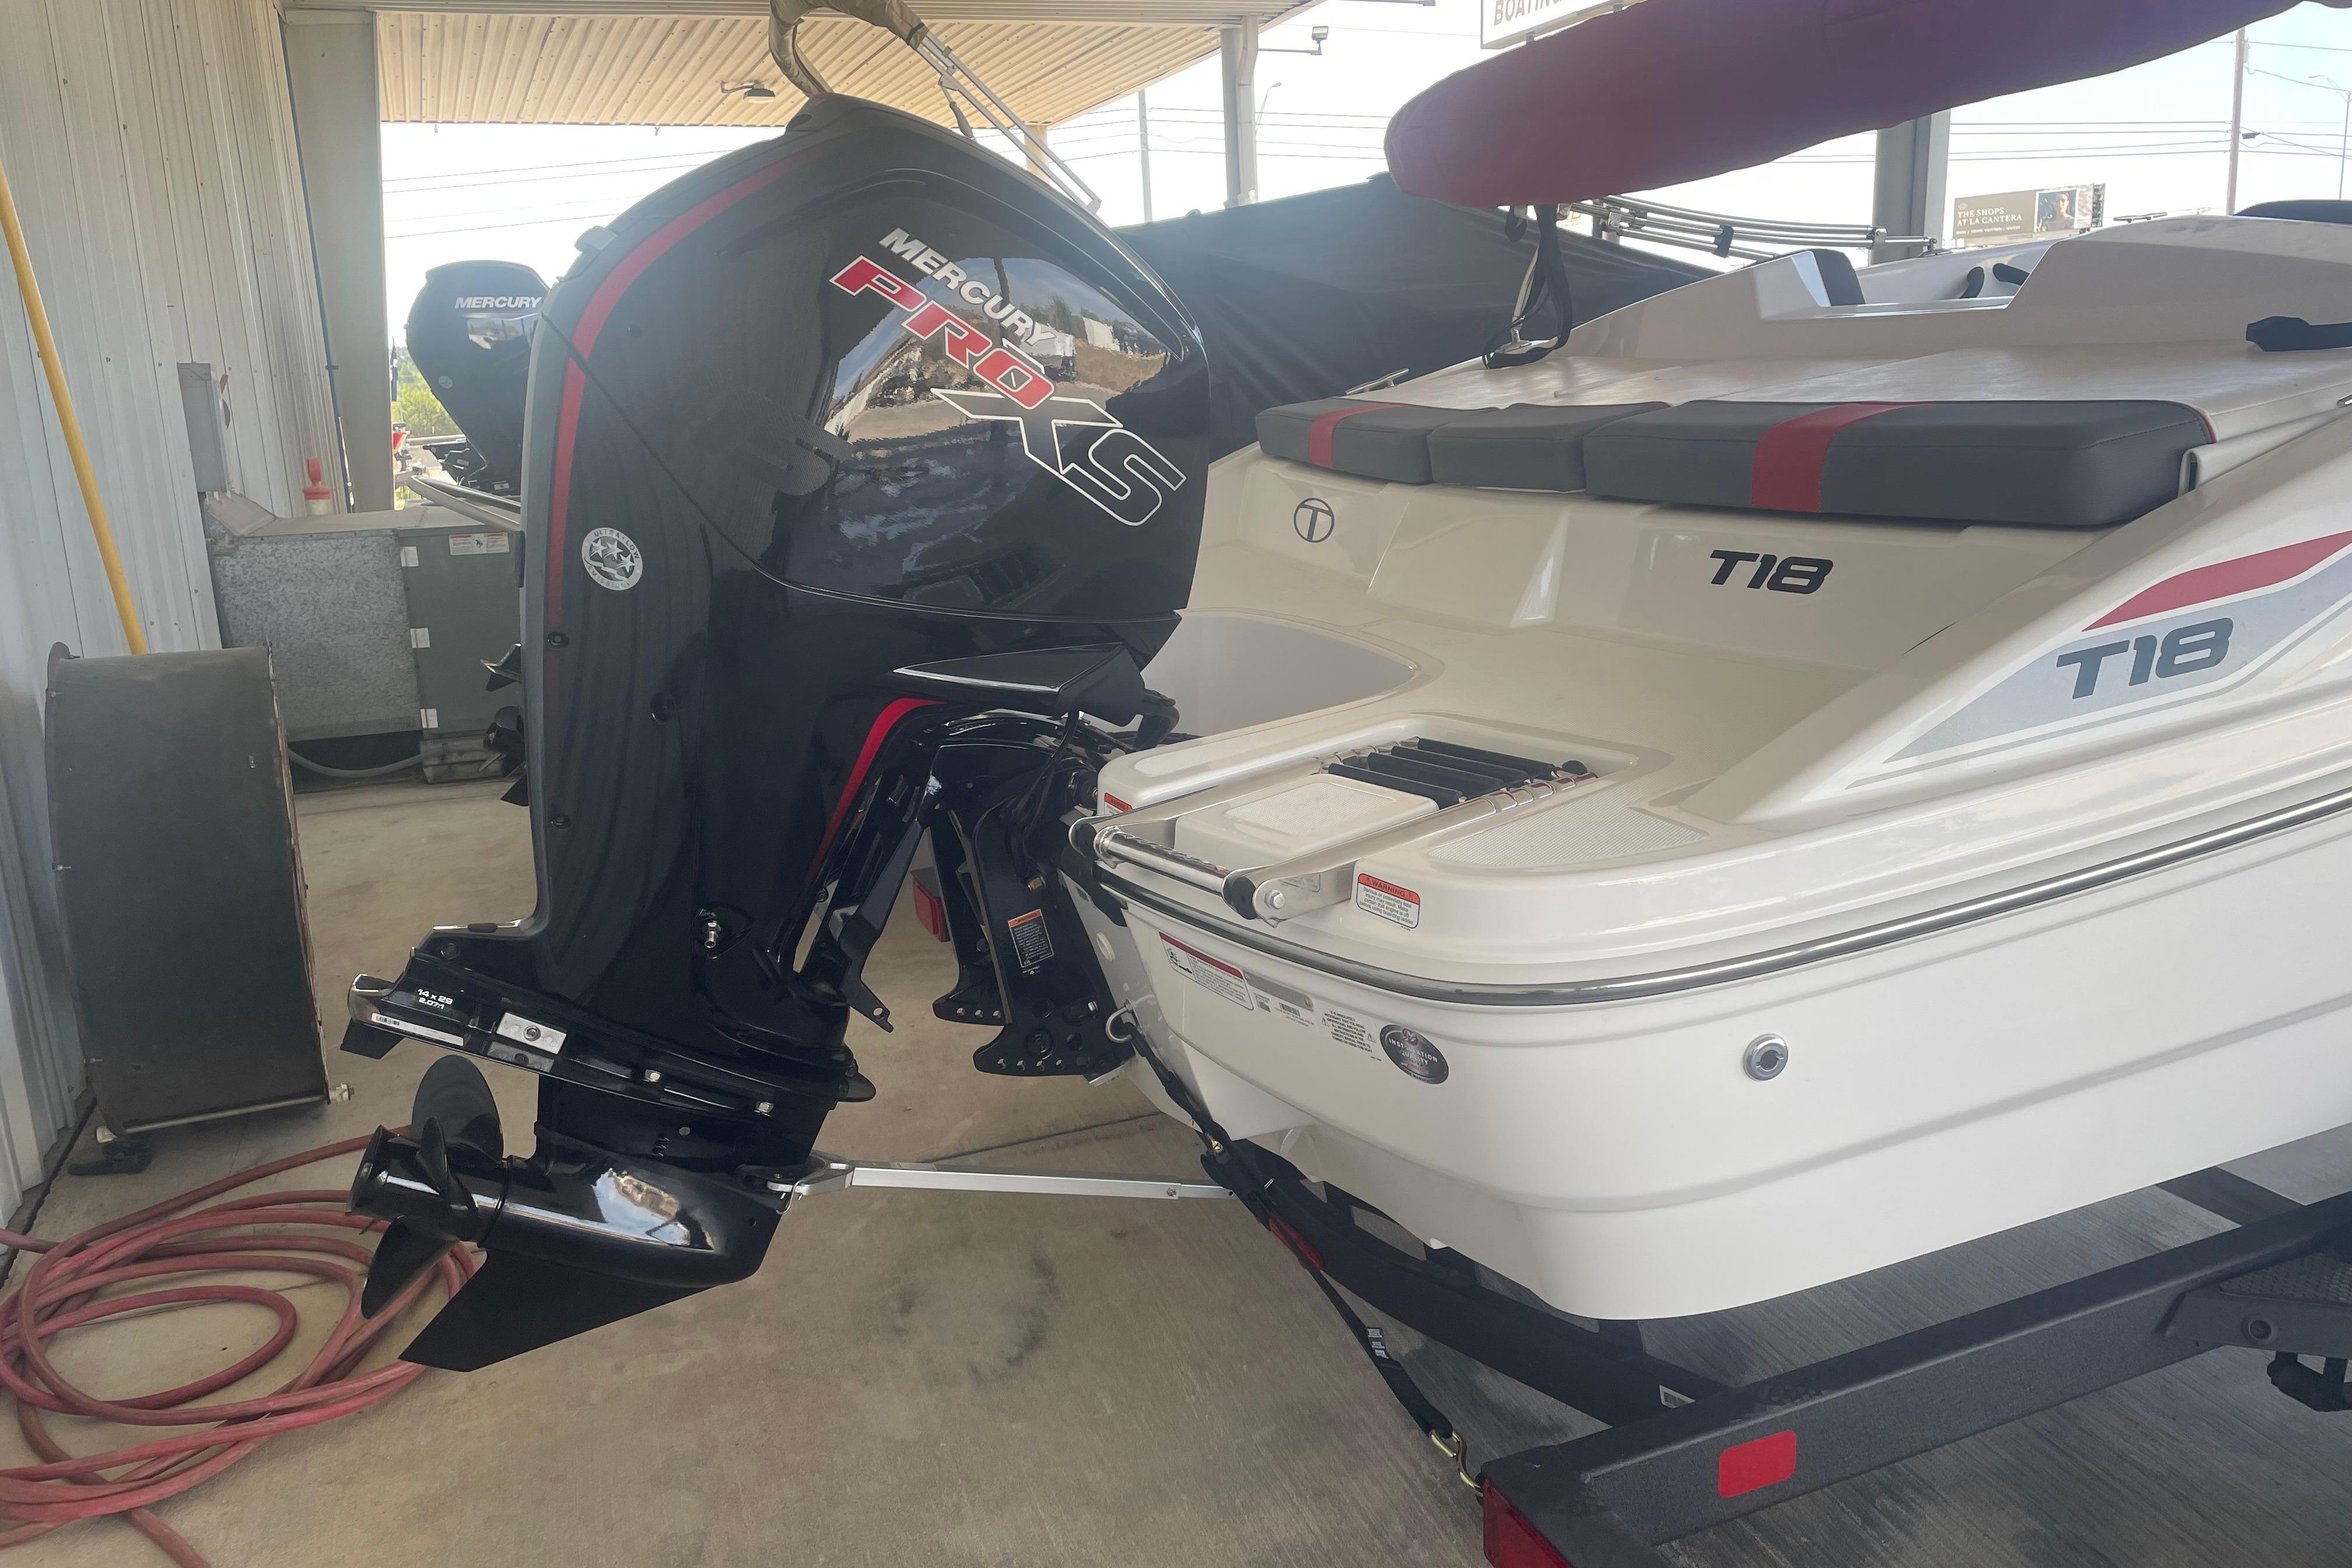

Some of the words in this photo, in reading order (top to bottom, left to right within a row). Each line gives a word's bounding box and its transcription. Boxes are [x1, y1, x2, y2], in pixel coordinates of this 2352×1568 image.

[1958, 210, 1975, 218] THE
[1977, 207, 2004, 216] SHOPS
[1982, 214, 2022, 224] CANTERA
[878, 228, 1055, 345] MERCURY
[454, 296, 542, 309] MERCURY
[829, 255, 1054, 410] PRO
[930, 338, 1186, 526] XS
[594, 528, 620, 539] ULTRA
[625, 540, 640, 559] LOW
[1710, 550, 1833, 594] T18
[2056, 617, 2234, 699] T18
[1372, 879, 1405, 897] WARNING
[417, 989, 429, 997] 14
[419, 997, 444, 1009] 2.07:1
